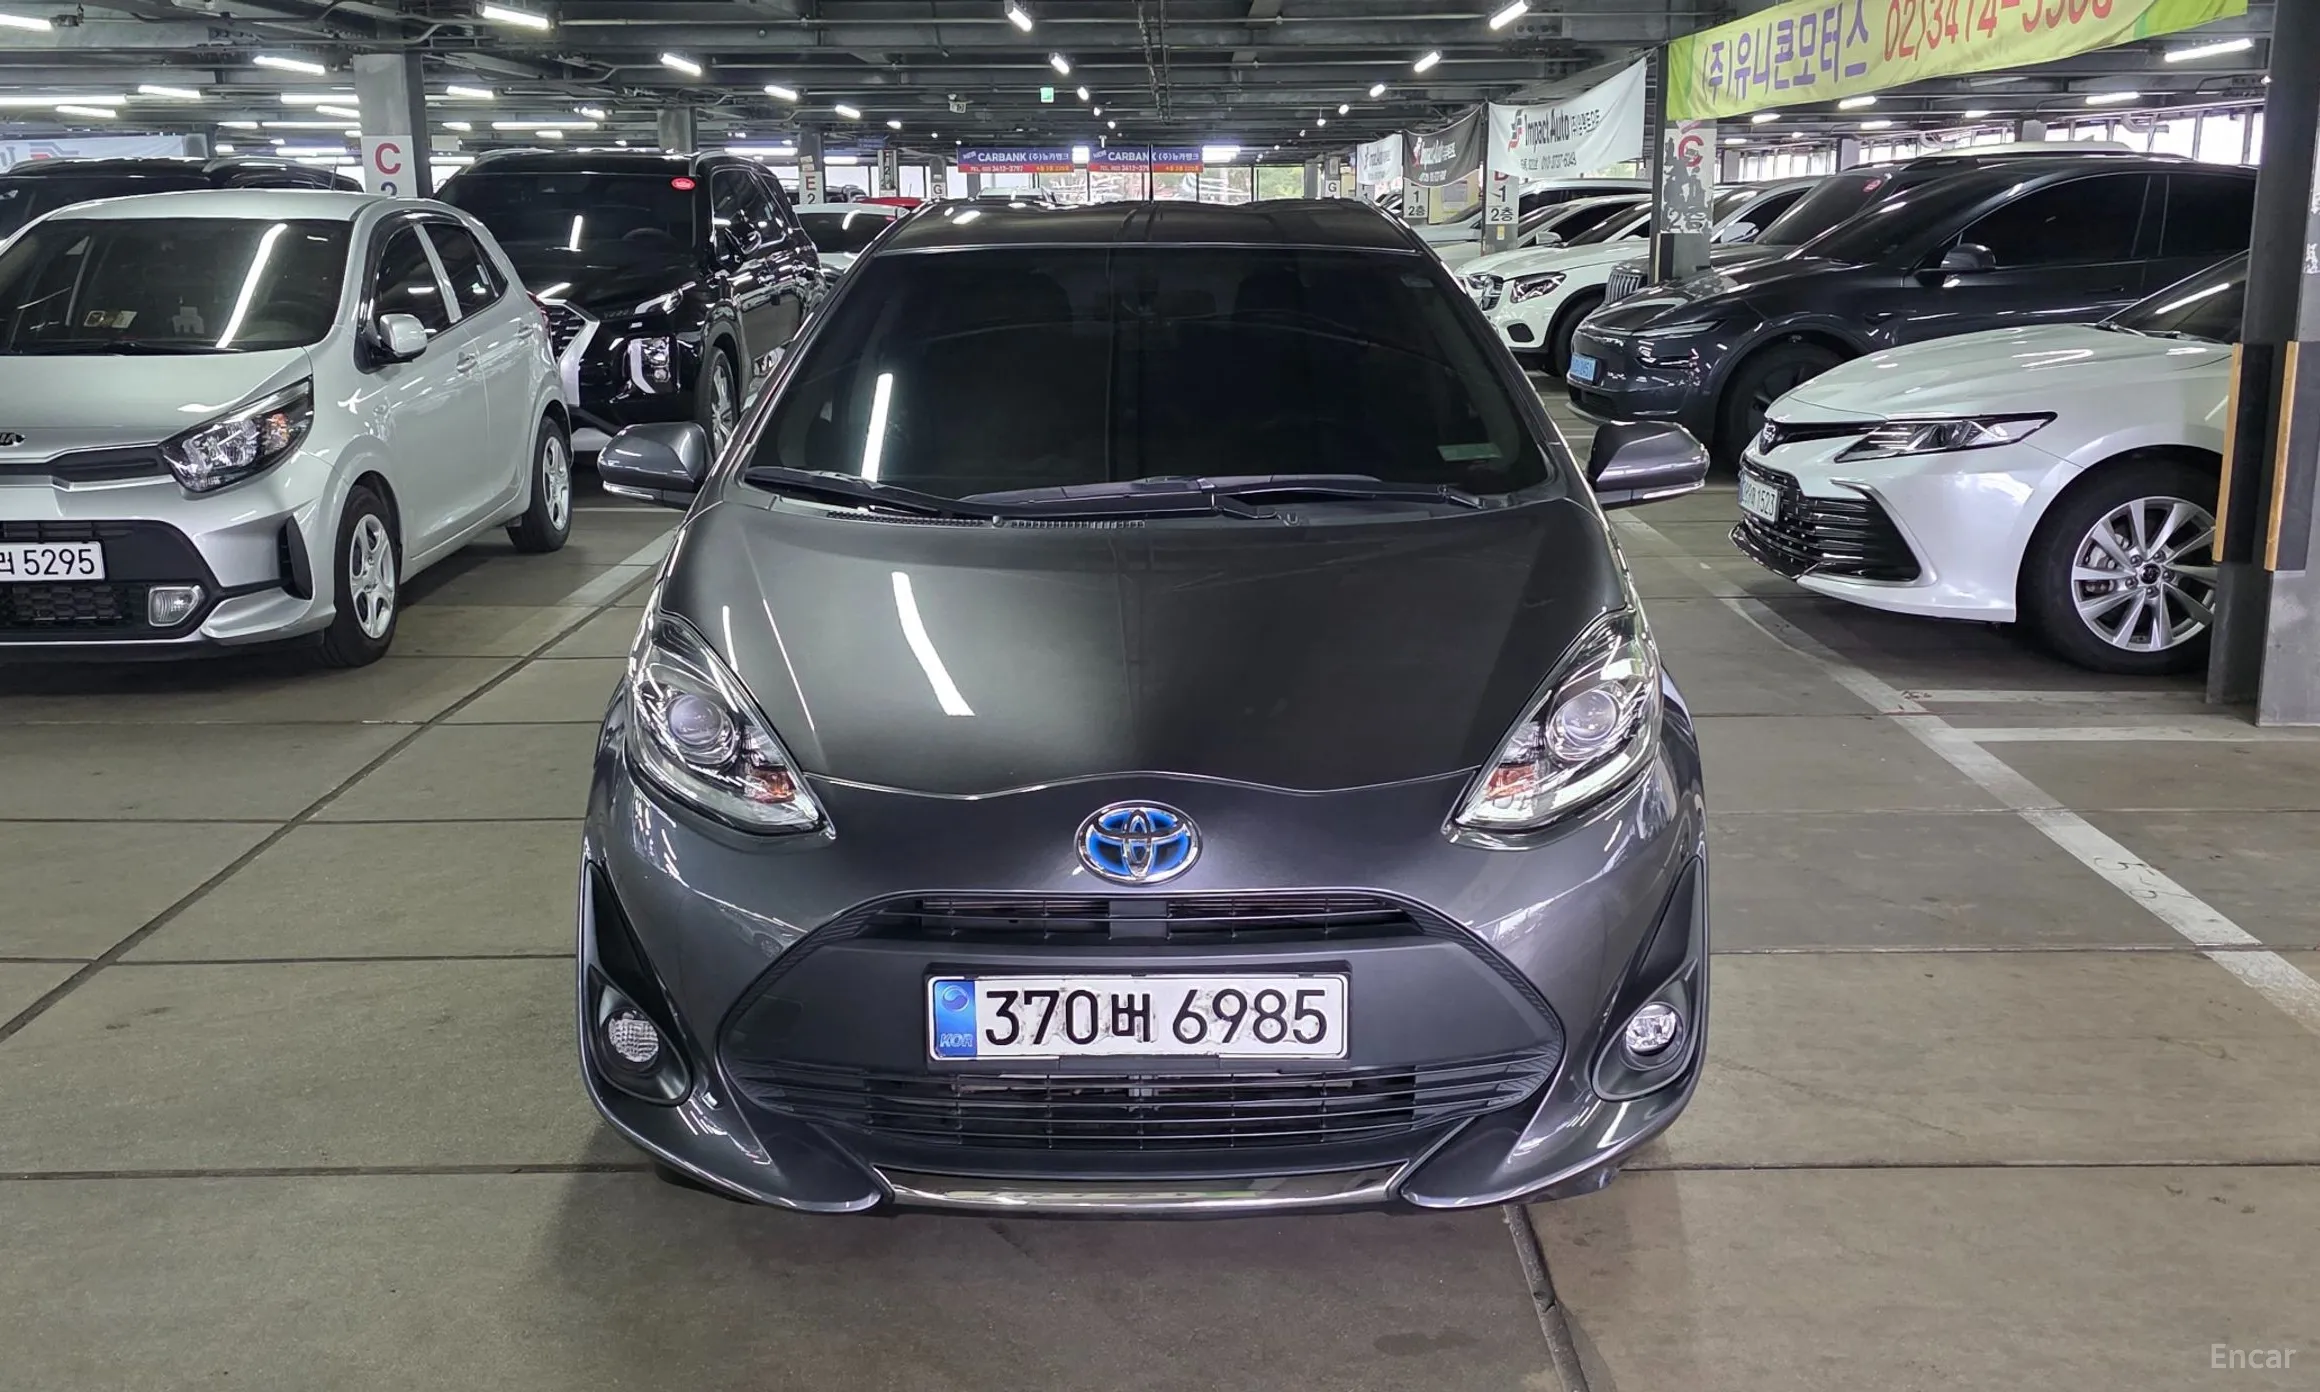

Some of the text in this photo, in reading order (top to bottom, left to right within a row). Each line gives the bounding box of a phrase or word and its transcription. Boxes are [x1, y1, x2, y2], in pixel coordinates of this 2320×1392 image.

[1702, 0, 2113, 105] (주)유니콘모터스 02)3474-
[1524, 113, 1551, 153] Impact
[1550, 108, 1570, 144] Auto
[375, 142, 401, 175] C
[977, 152, 1027, 162] CARBANK
[1107, 151, 1157, 161] CARBANK
[805, 176, 816, 190] E
[933, 184, 943, 195] G
[1328, 182, 1338, 193] G
[1413, 190, 1420, 203] 1
[1498, 184, 1507, 203] 1
[1490, 206, 1514, 222] 2층
[23, 548, 95, 576] 5295
[985, 988, 1327, 1046] 370버 6985
[940, 1033, 973, 1048] KOR
